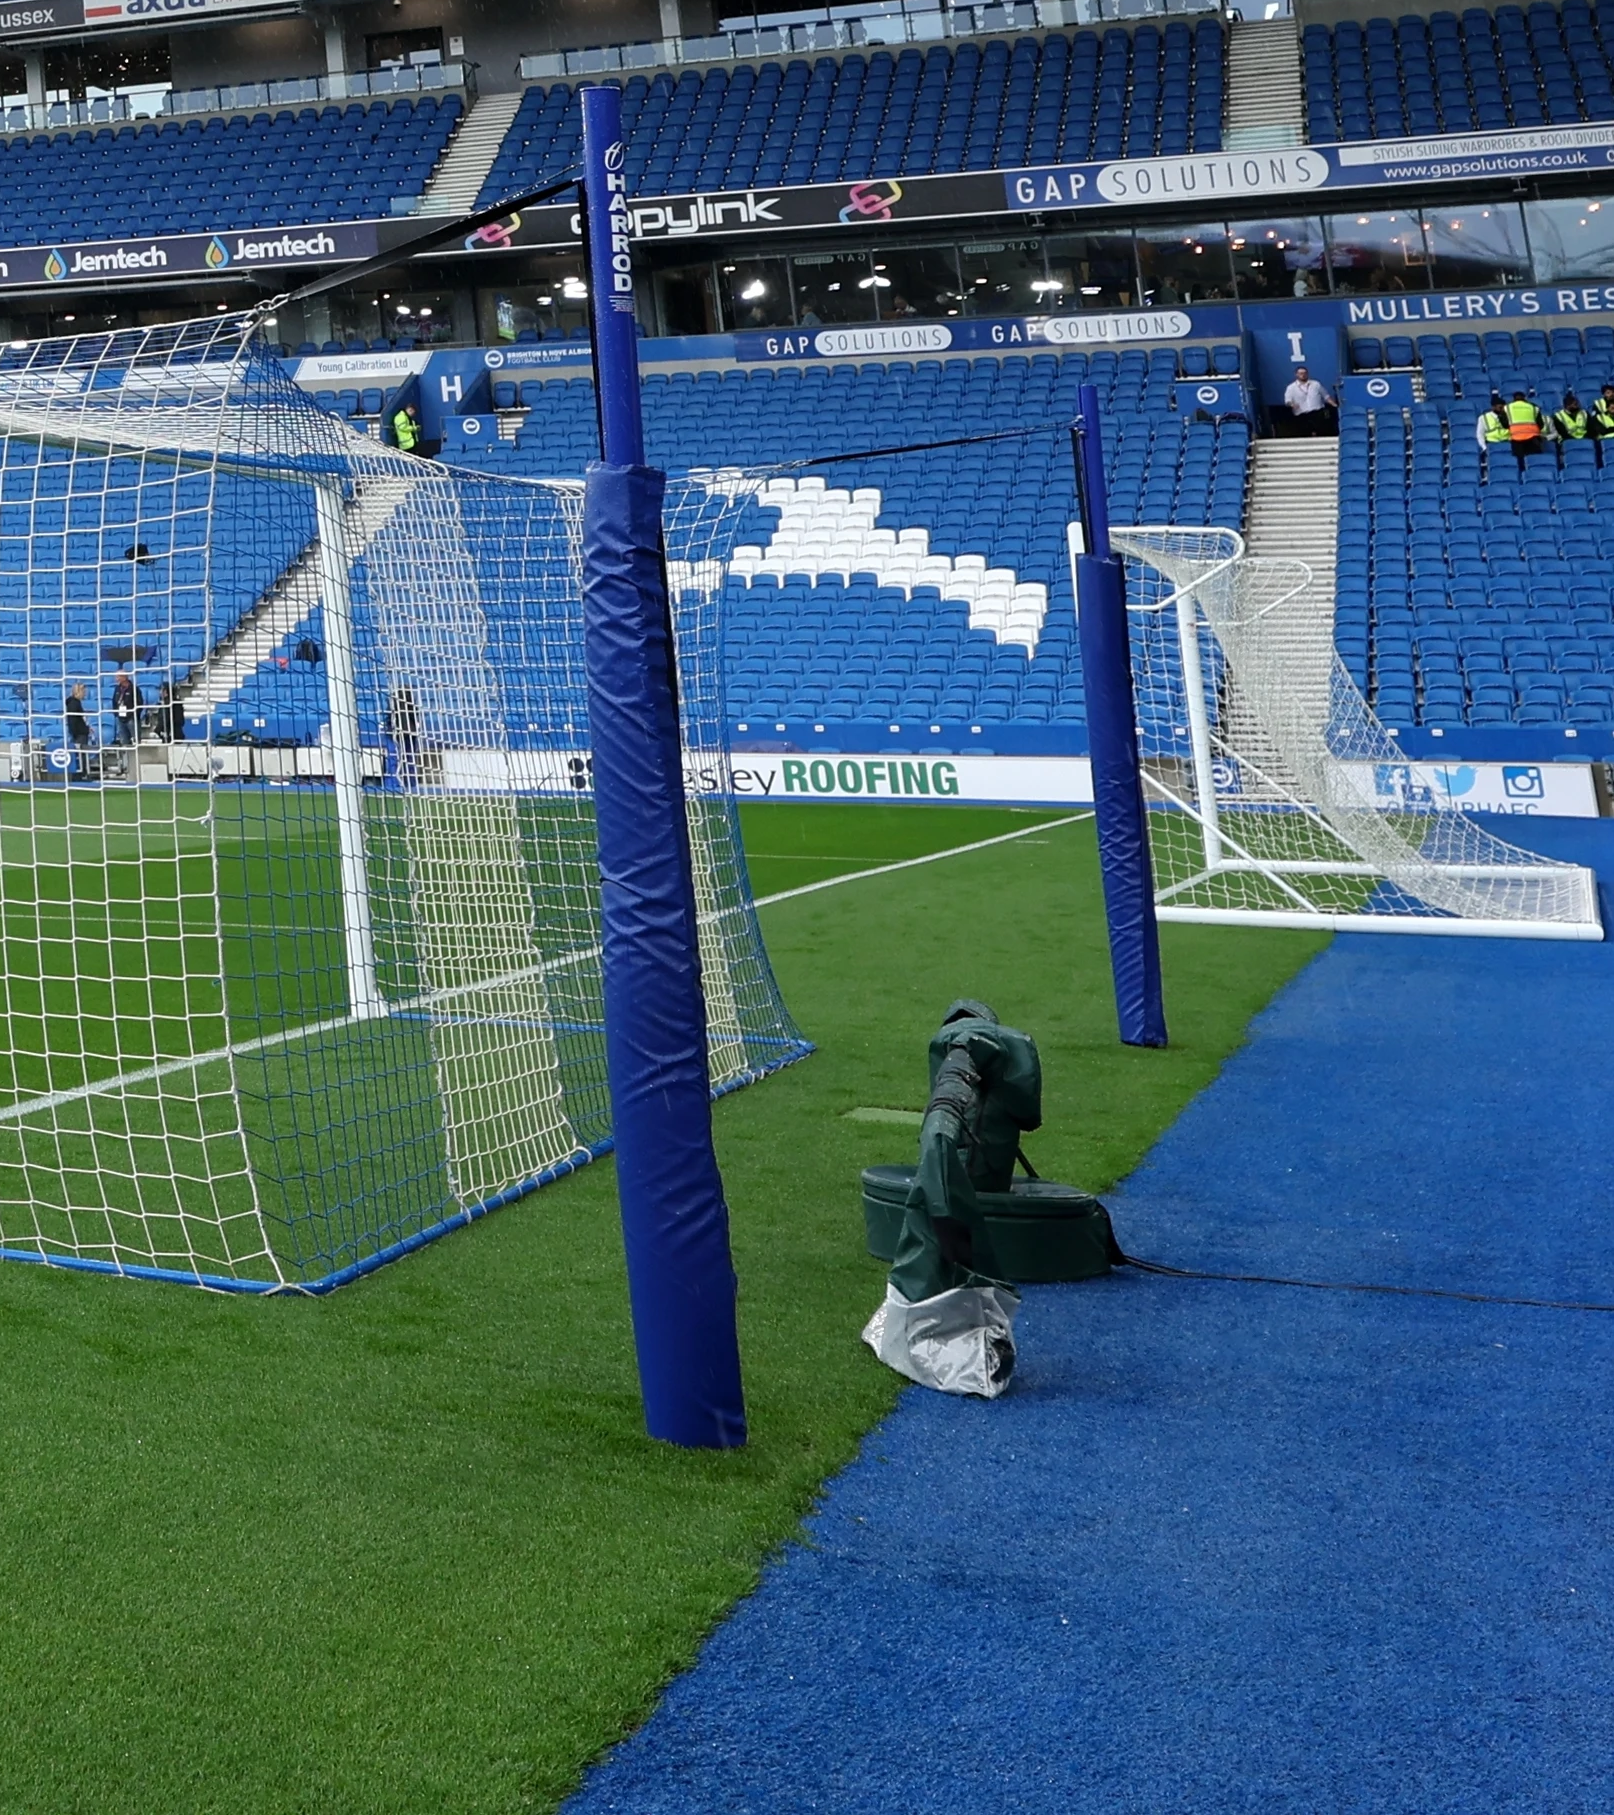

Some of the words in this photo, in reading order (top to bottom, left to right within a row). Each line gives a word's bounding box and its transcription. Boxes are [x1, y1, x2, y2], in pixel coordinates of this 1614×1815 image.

[1373, 146, 1414, 162] STYLISH
[1417, 142, 1458, 157] SLIDING
[1460, 137, 1527, 153] WARDROBES
[1528, 135, 1537, 147] &
[1540, 132, 1572, 147] ROOM
[1384, 151, 1589, 178] www.gapsolutions.co.uk
[1016, 173, 1087, 204] GAP
[1112, 157, 1312, 197] SOLUTIONS
[233, 232, 336, 261] Jemtech
[607, 173, 633, 292] HARROD
[70, 245, 167, 273] Jemtech
[1349, 291, 1540, 324] MULLERY'S
[766, 337, 809, 356] GAP
[823, 328, 943, 352] SOLUTIONS
[992, 324, 1038, 343] GAP
[1054, 315, 1182, 338] SOLUTIONS
[1287, 331, 1305, 362] I
[317, 361, 343, 374] Young
[345, 358, 392, 371] Calibration
[394, 357, 408, 368] Ltd
[441, 376, 463, 403] H
[782, 759, 960, 796] ROOFING
